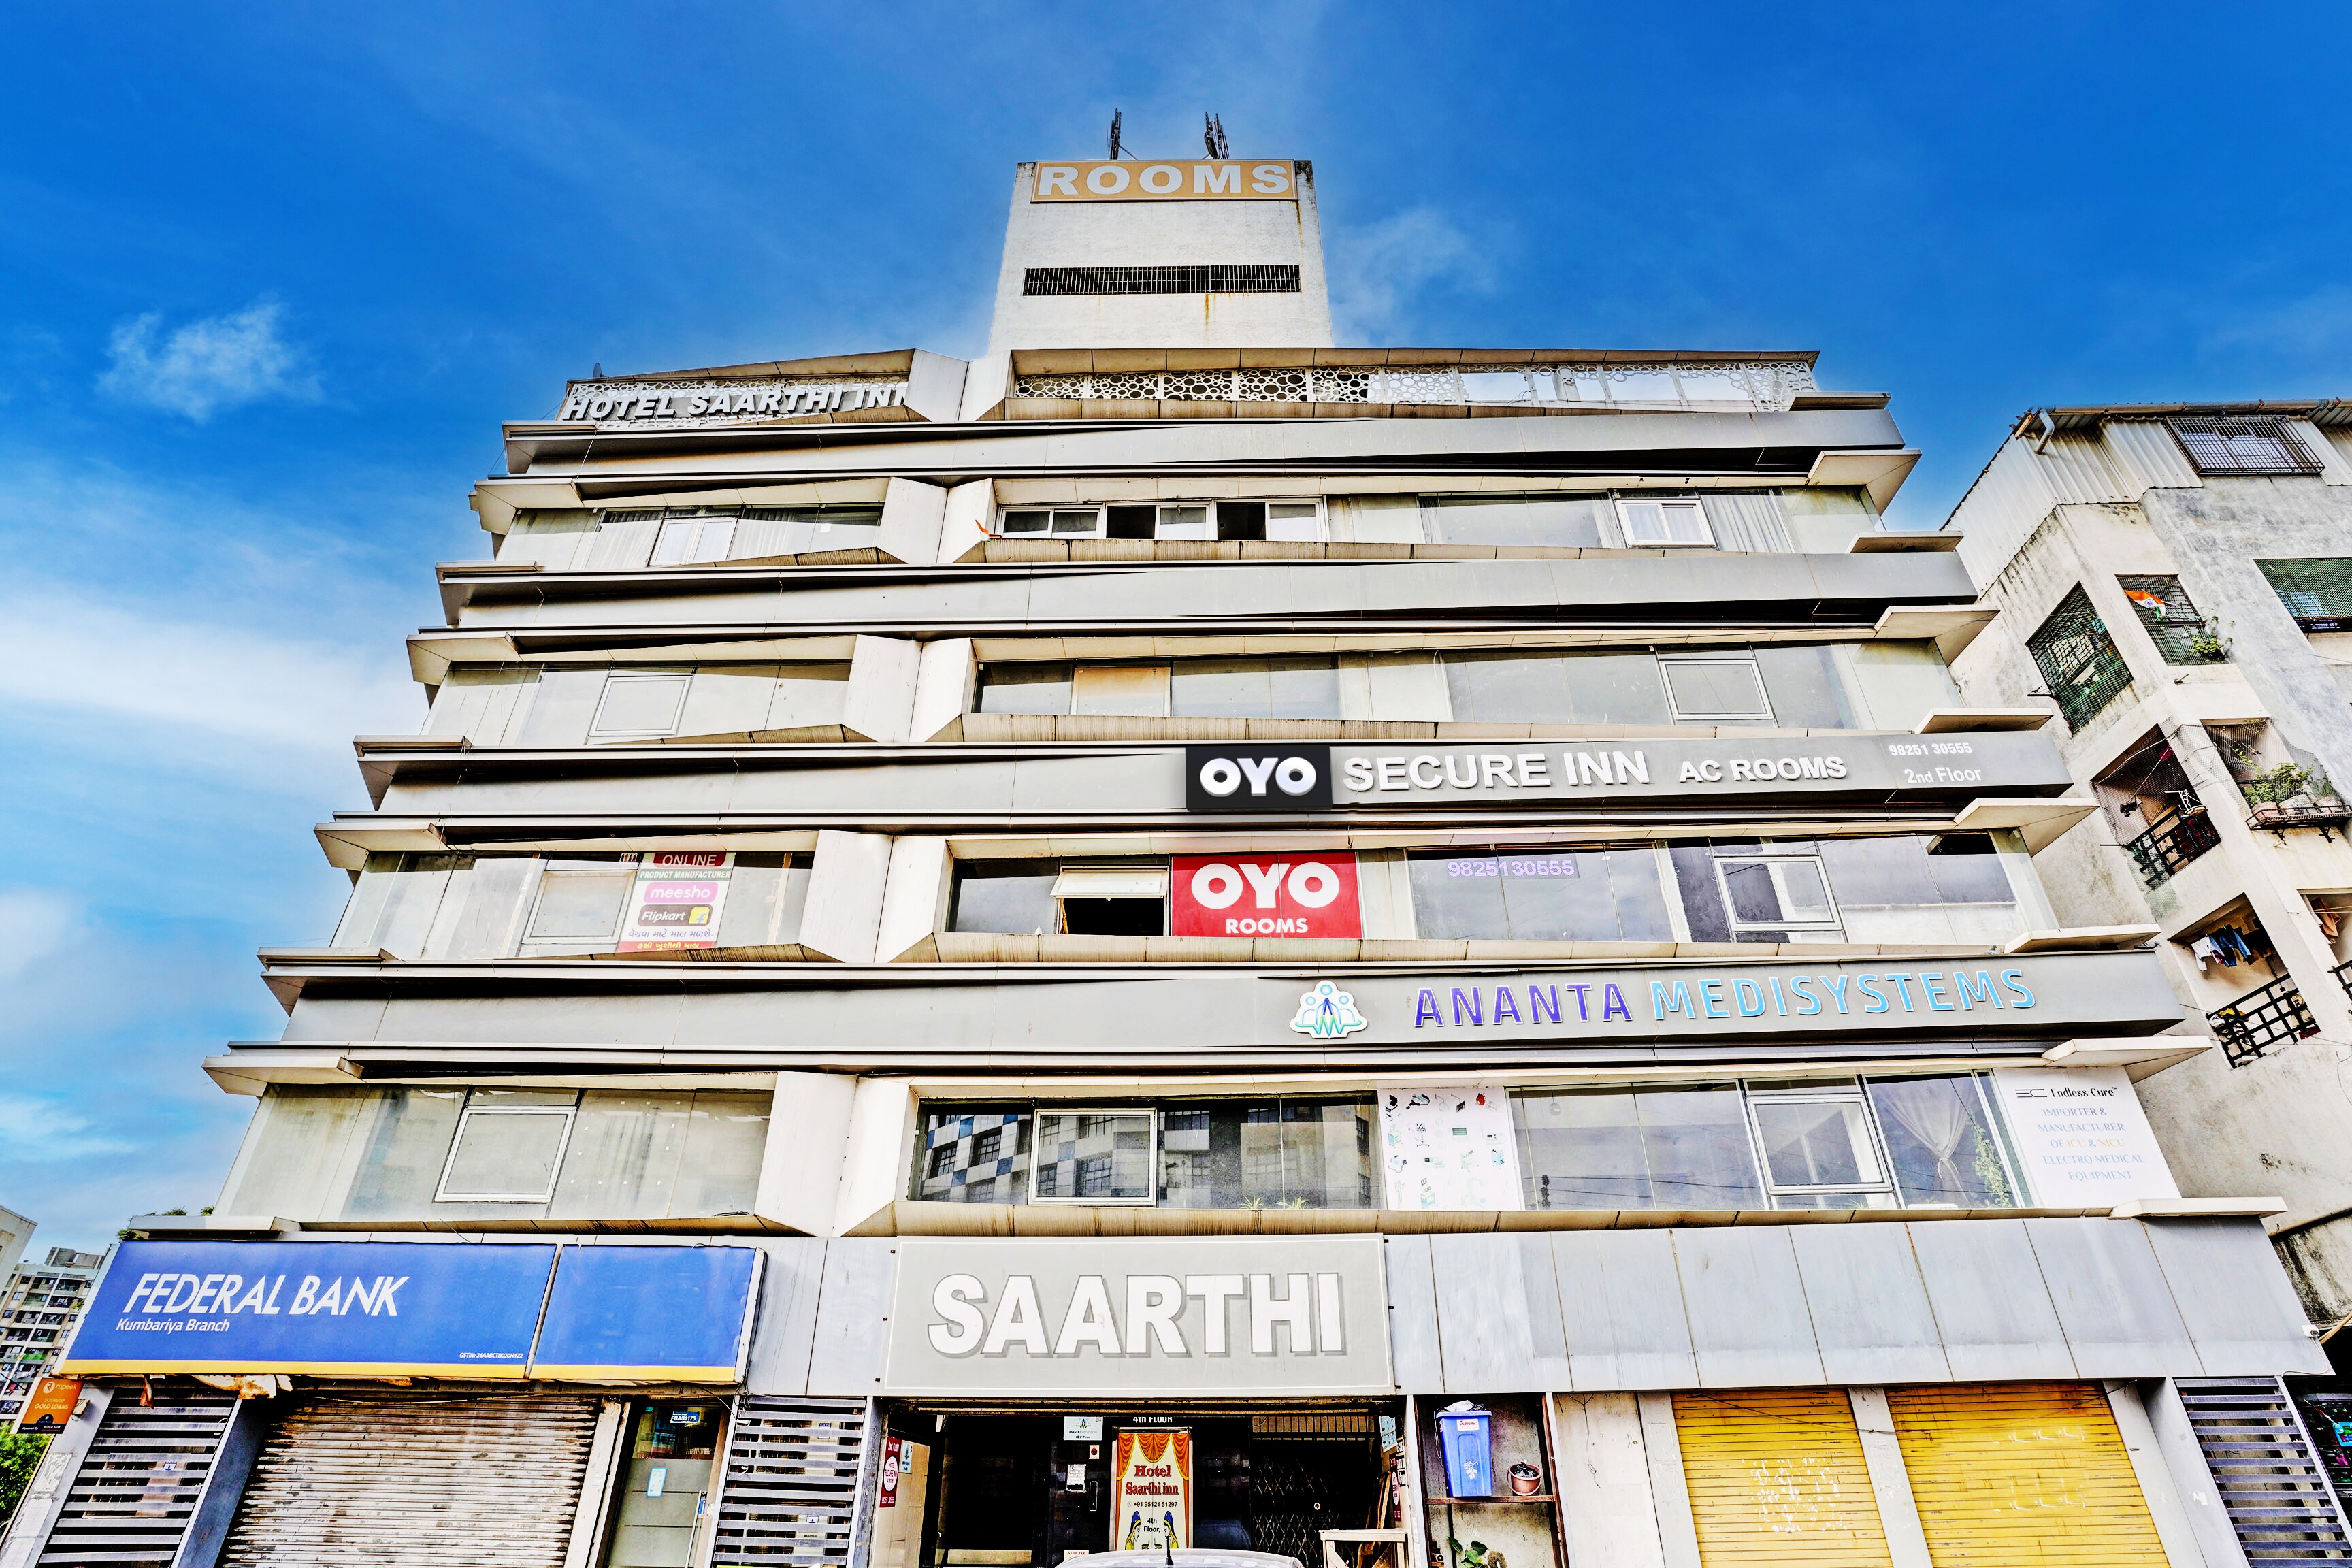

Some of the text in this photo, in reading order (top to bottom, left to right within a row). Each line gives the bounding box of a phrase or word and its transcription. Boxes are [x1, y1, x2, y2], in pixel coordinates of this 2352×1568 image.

[1038, 164, 1290, 195] ROOMS
[563, 395, 676, 420] HOTEL
[687, 387, 843, 418] SAARTHI
[1889, 742, 1973, 756] 98251 30555
[1200, 757, 1316, 797] OYO
[1343, 750, 1848, 792] SECURE INN AC ROOMS
[1904, 767, 1982, 783] 2nd Floor
[662, 854, 717, 866] ONLINE
[640, 870, 731, 879] PRODUCT MANUFACTURER
[1447, 860, 1574, 877] 9825130555
[651, 885, 710, 898] meesho
[1191, 862, 1340, 910] OYO
[641, 911, 686, 923] Flipkart
[1225, 917, 1309, 934] ROOMS
[1414, 968, 2036, 1028] ANANTA MEDISYSTEMS
[2043, 1107, 2108, 1117] IMPORTER &
[2038, 1123, 2125, 1132] MANUFACTURER
[2050, 1139, 2063, 1148] OF
[2097, 1138, 2125, 1147] NICU
[2043, 1154, 2144, 1164] ELECTRO MEDICAL
[2068, 1171, 2133, 1181] EQUIPMENT
[122, 1273, 410, 1316] FEDERAL BANK
[927, 1273, 1346, 1358] SAARTHI
[116, 1318, 230, 1334] Kumbariya Branch
[1134, 1465, 1171, 1477] Hotel
[1126, 1481, 1179, 1495] Saarthi inn
